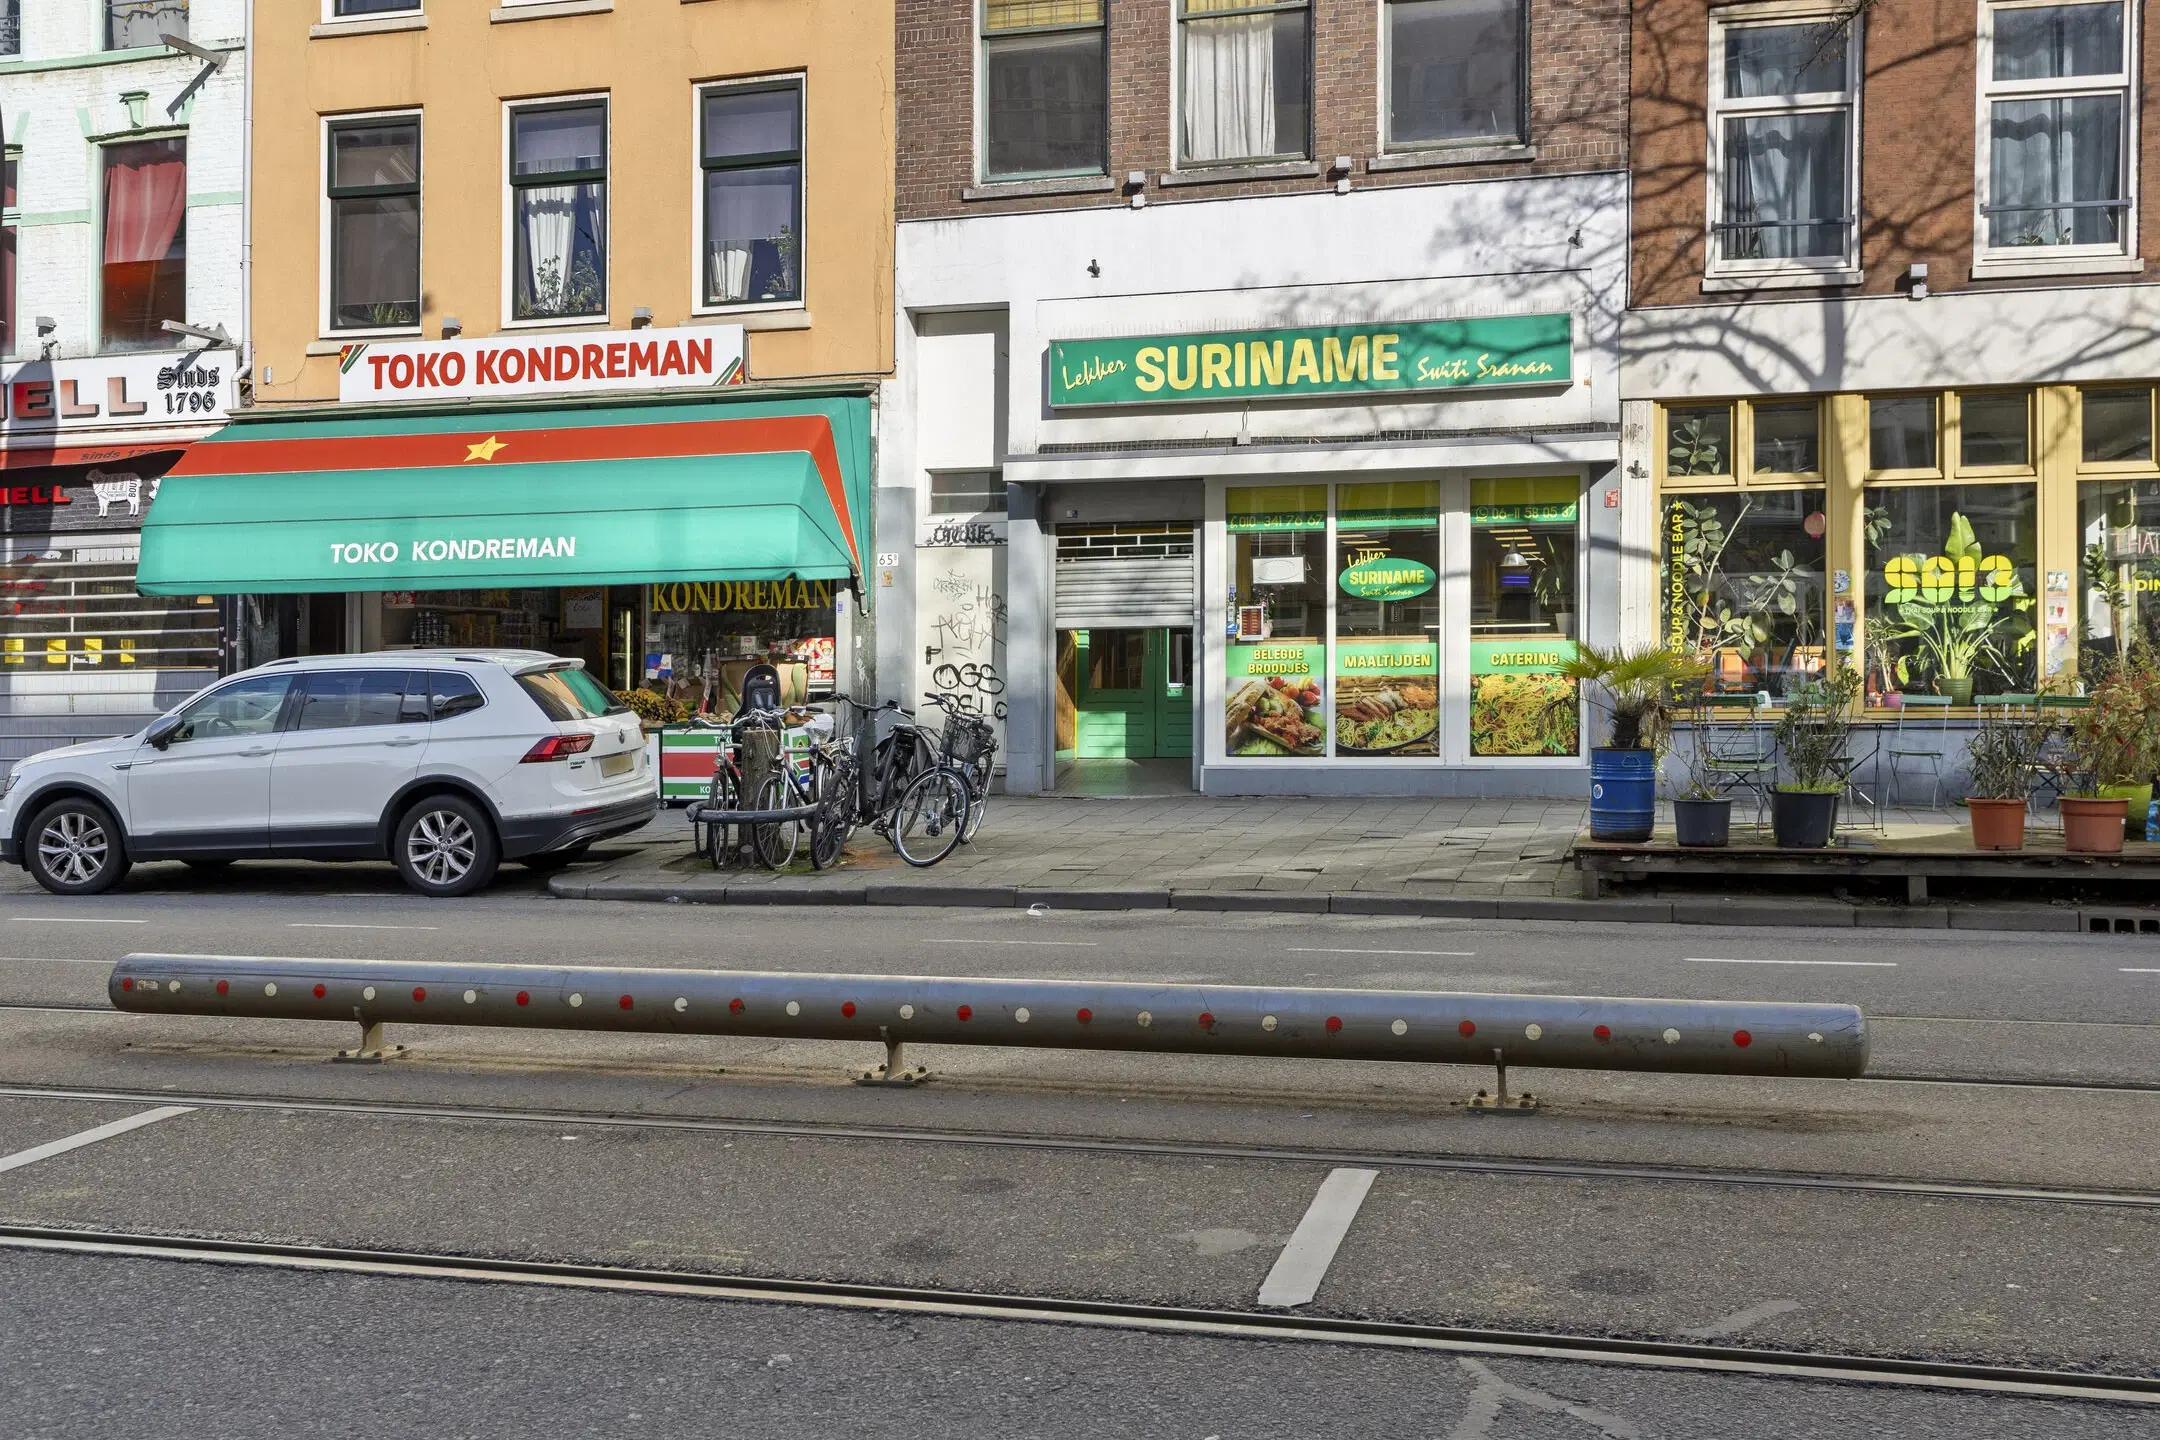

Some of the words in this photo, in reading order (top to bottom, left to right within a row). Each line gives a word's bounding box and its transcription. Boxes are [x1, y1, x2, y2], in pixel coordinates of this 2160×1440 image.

[368, 351, 466, 390] TOKO
[476, 338, 713, 385] KONDREMAN
[1062, 355, 1128, 391] Lekker
[1134, 333, 1400, 392] SURINAME
[1417, 356, 1470, 382] Switi
[1476, 353, 1554, 379] Sranan
[157, 365, 221, 390] Sinds
[0, 377, 148, 422] ELL
[164, 390, 217, 415] 1796
[81, 450, 121, 461] sinds
[1671, 514, 1684, 541] BAR
[330, 541, 399, 564] TOKO
[412, 536, 576, 562] KONDREMAN
[1347, 549, 1386, 568] Lekker
[1348, 569, 1425, 585] SURINAME
[1671, 546, 1684, 603] NOODLE
[651, 577, 833, 613] KONDREMAN
[1947, 606, 1976, 614] NOODLE
[1671, 617, 1684, 654] SOUP
[1253, 648, 1304, 661] BELEGDE
[1343, 653, 1432, 669] MAALTIJDEN
[1490, 652, 1560, 667] CATERING
[1248, 662, 1310, 675] BROODJES
